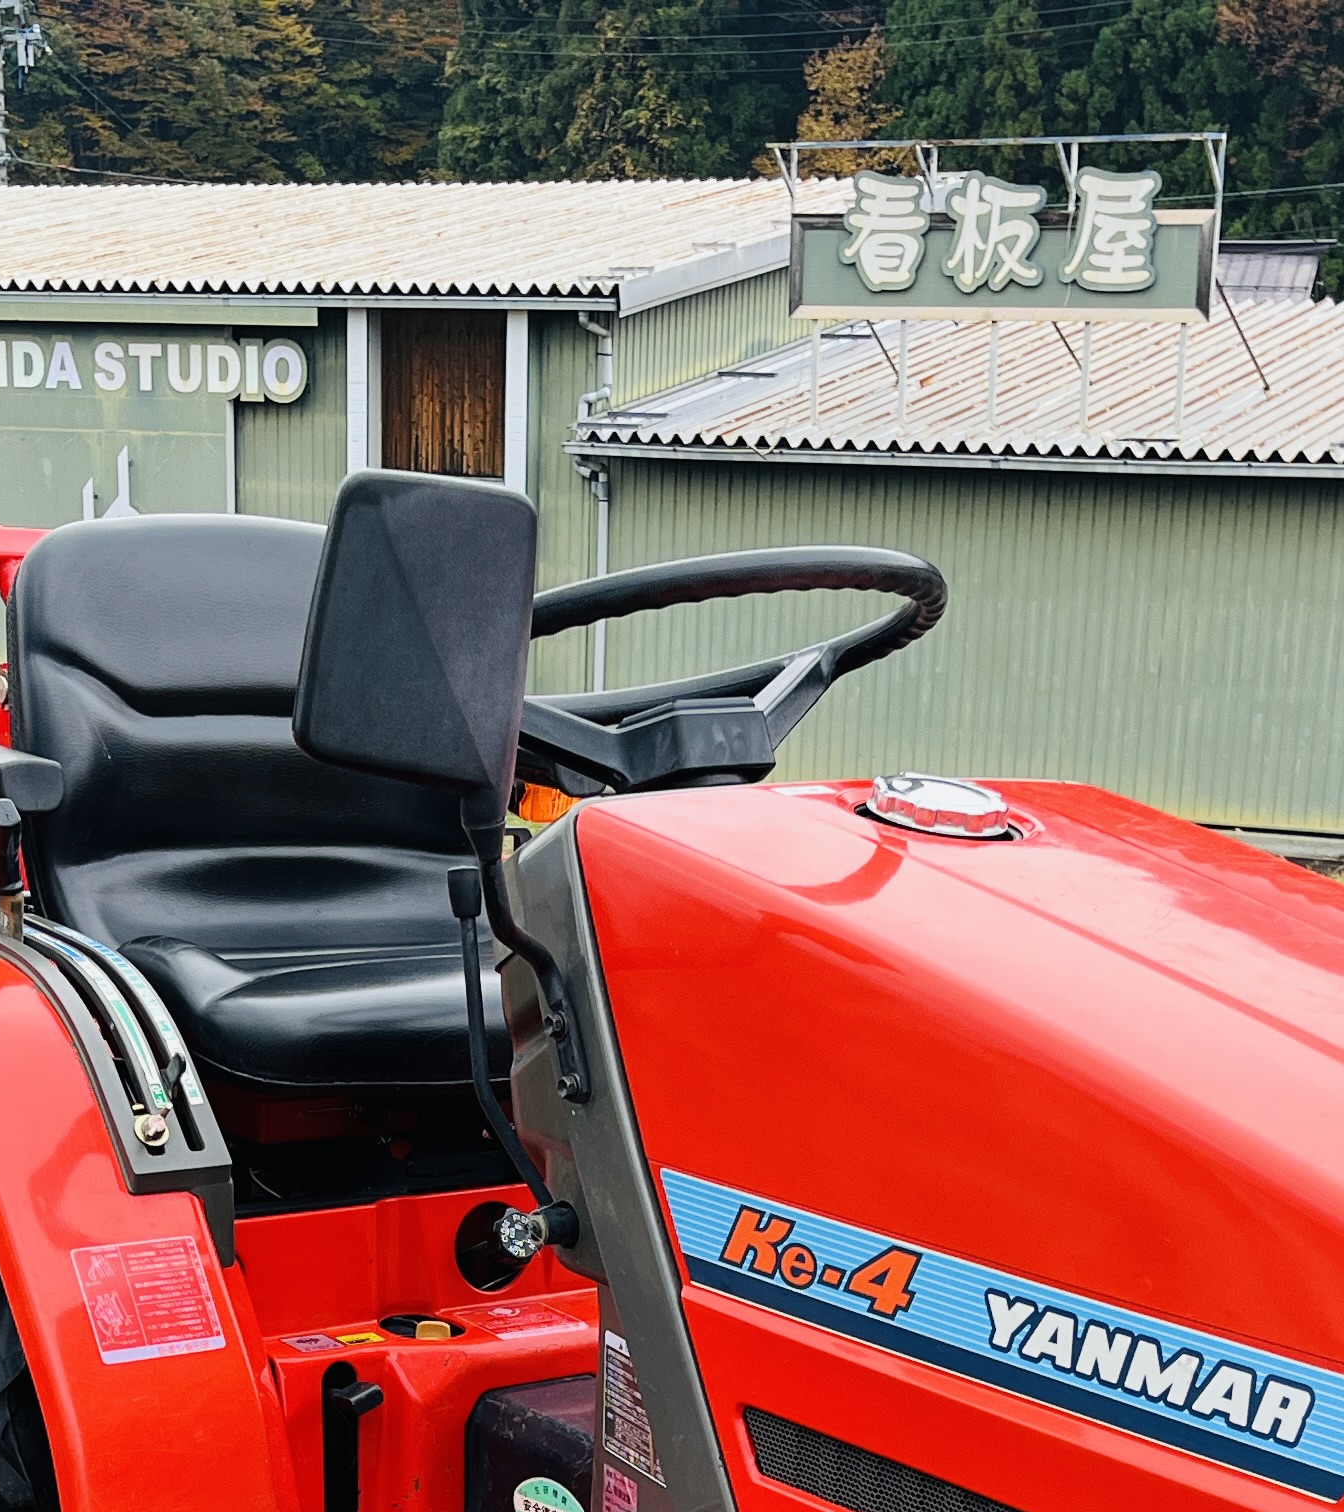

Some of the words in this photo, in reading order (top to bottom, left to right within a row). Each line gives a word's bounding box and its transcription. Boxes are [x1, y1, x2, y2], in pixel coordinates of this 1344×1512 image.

[842, 172, 1158, 288] 看板屋
[93, 340, 304, 397] STUDIO
[719, 1205, 923, 1319] Ke-4
[983, 1289, 1315, 1448] YANMAR
